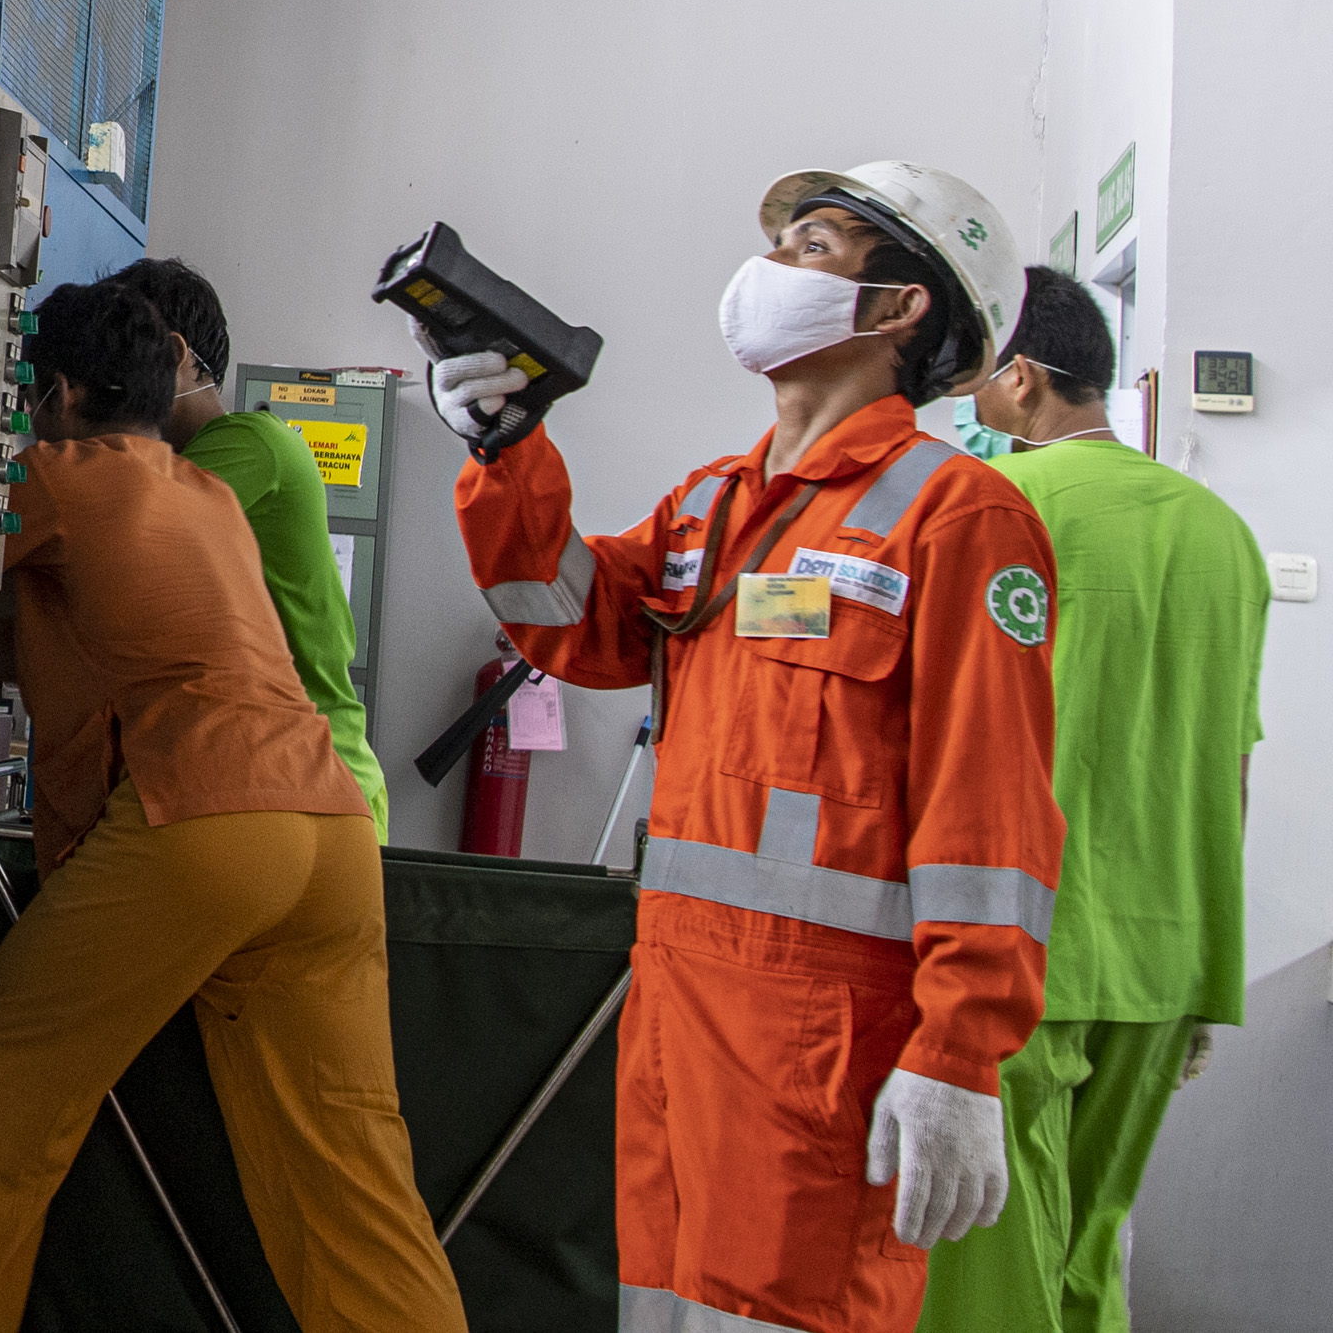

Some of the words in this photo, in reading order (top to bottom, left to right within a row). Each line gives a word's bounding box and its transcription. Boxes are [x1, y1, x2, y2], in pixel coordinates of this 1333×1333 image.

[303, 387, 326, 395] LOKASI
[299, 396, 329, 404] LAUNDRY
[308, 441, 339, 450] LEMARI
[314, 451, 361, 461] BERBAHAYA
[316, 461, 351, 470] ERACUN
[838, 563, 904, 595] SOLUTION
[483, 716, 494, 772] ANAKO
